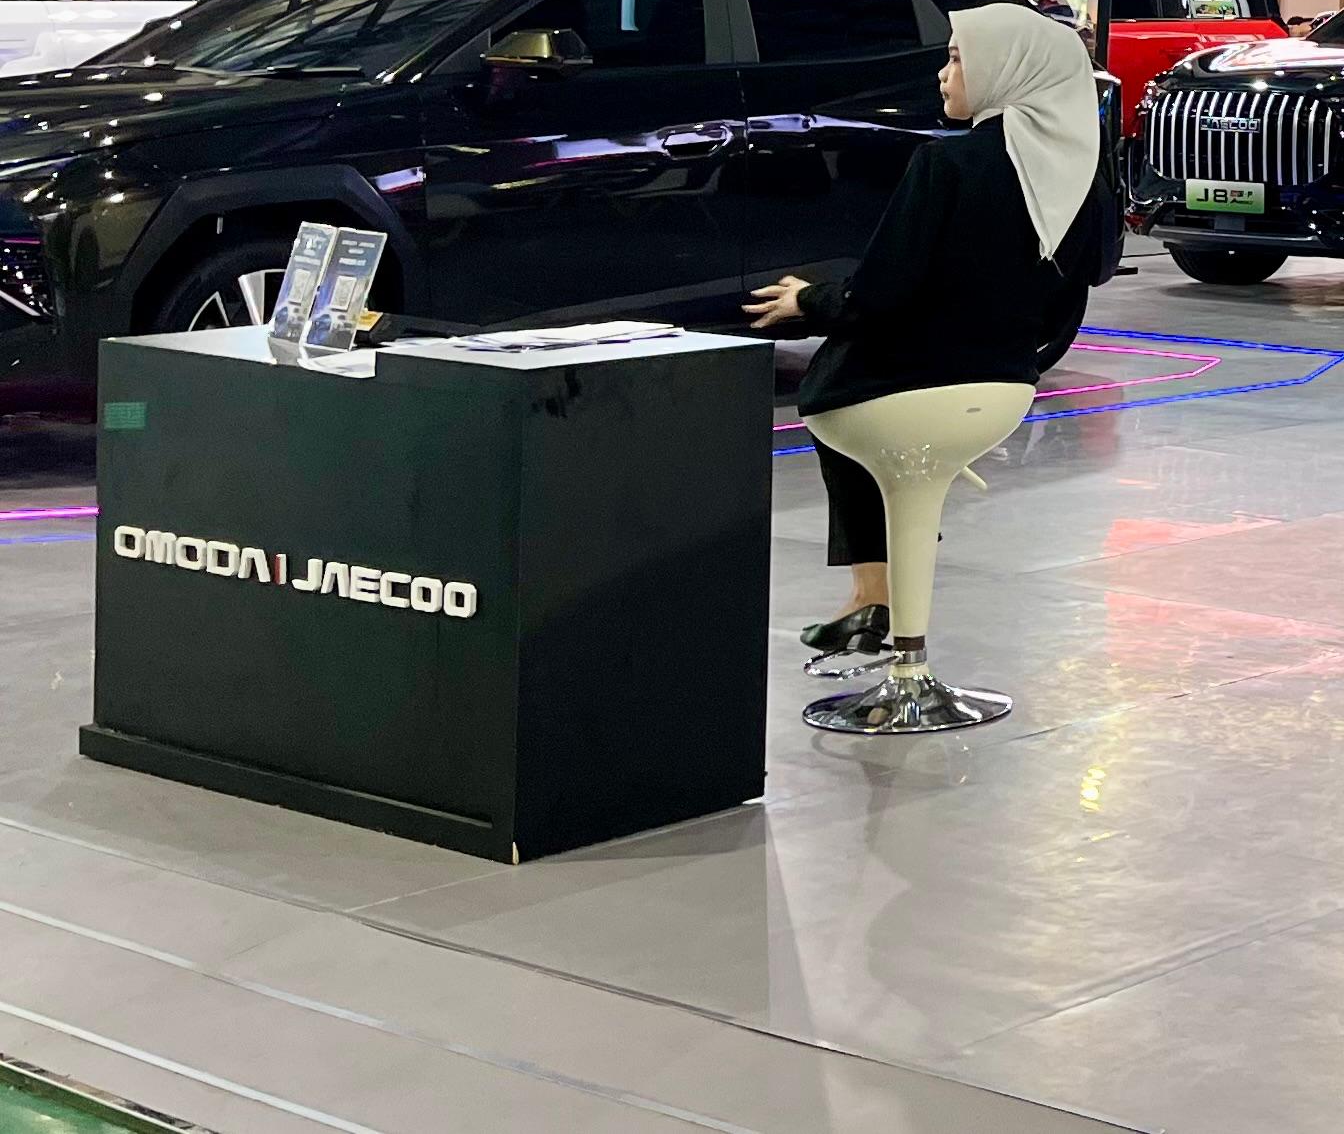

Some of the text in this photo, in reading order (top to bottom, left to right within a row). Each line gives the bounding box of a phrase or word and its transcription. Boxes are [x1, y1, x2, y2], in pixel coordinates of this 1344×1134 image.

[1196, 188, 1228, 203] J8
[114, 525, 477, 618] OMODA JAECOO
